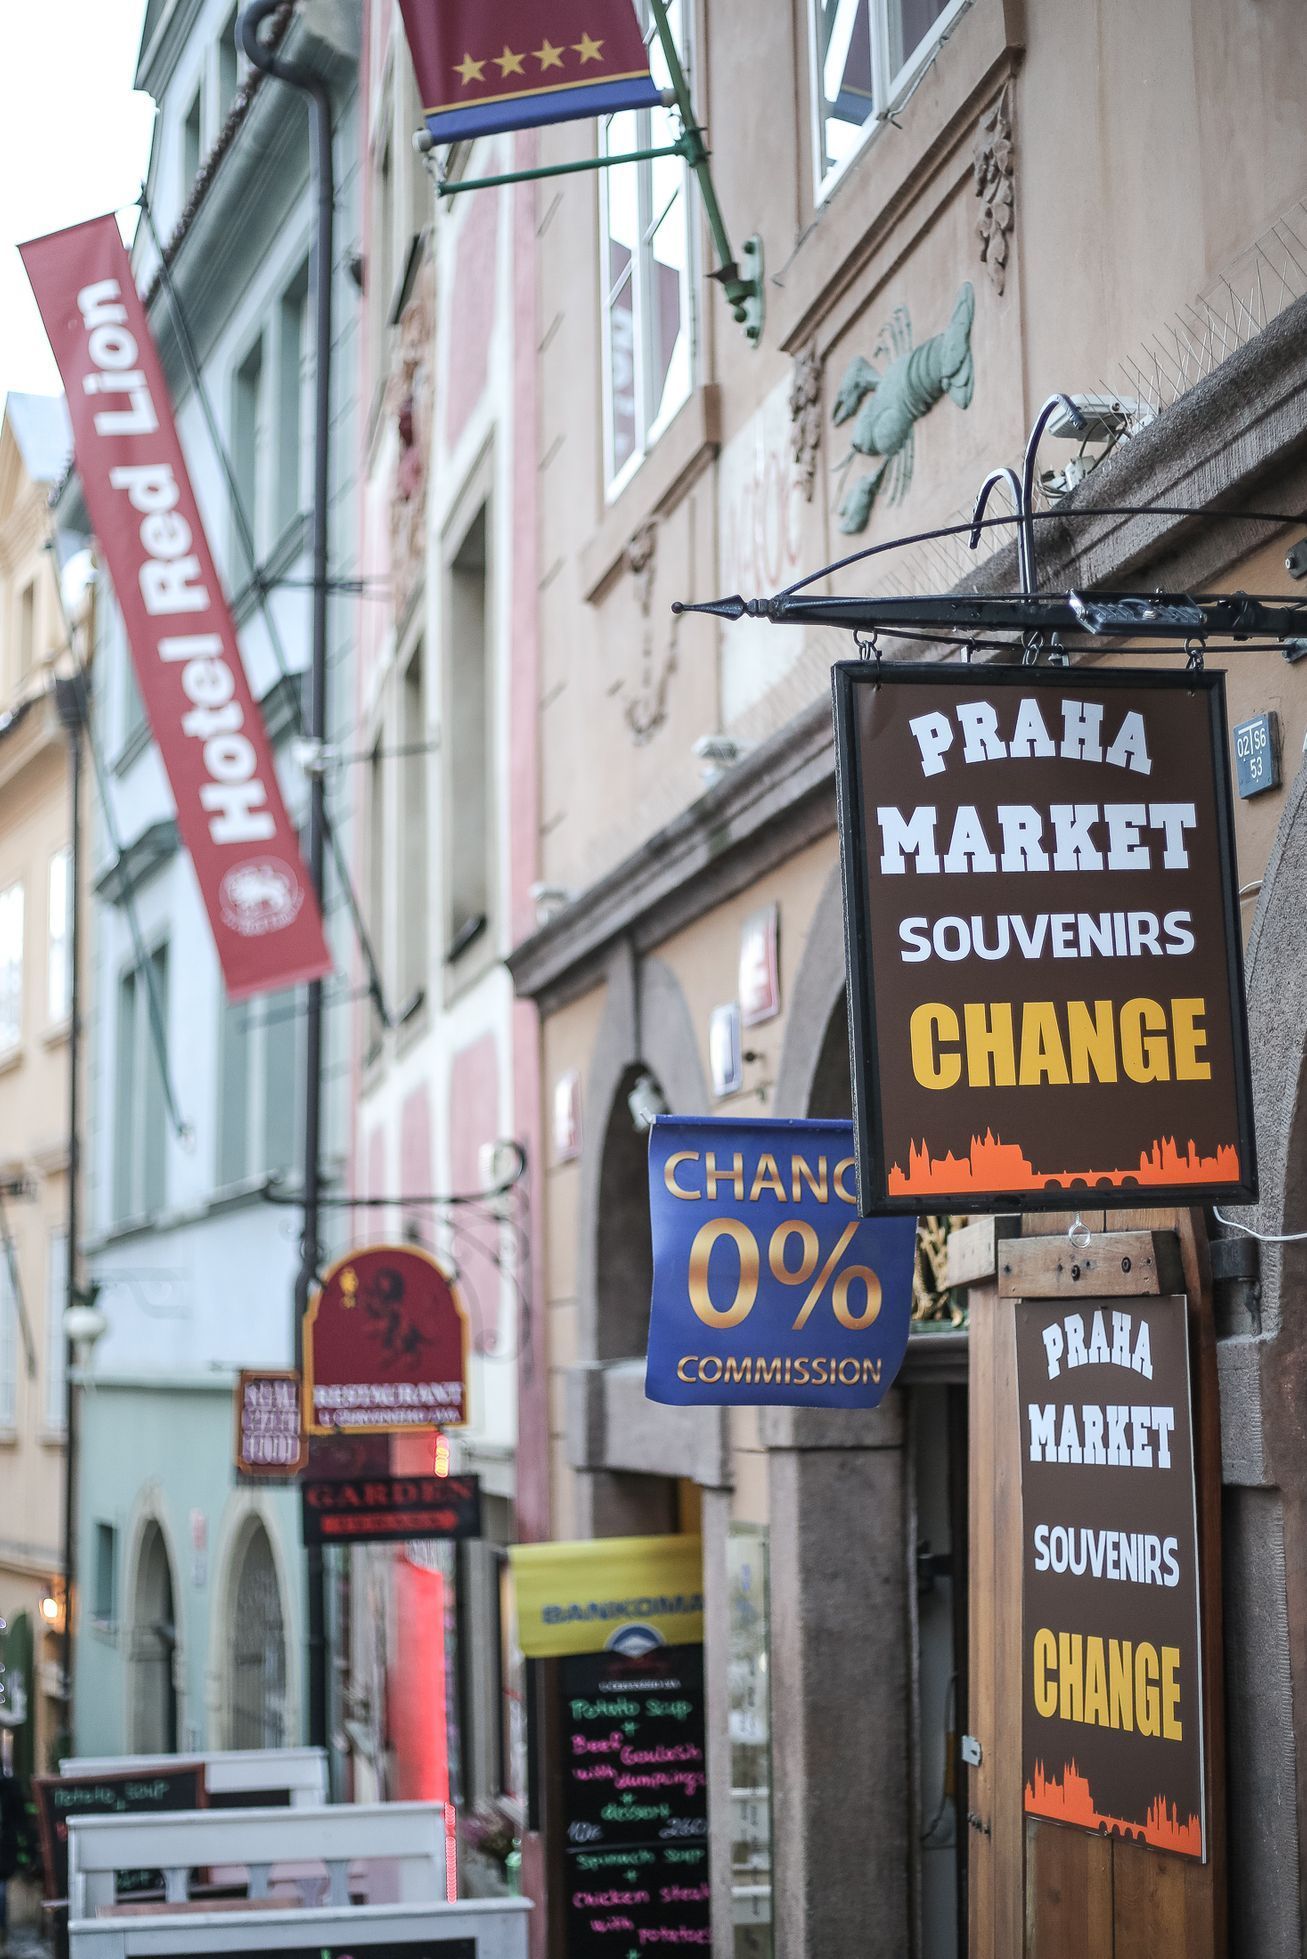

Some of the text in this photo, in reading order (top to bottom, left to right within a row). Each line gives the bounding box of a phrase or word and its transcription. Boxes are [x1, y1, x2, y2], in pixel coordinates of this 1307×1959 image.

[77, 278, 159, 436] Lion
[109, 463, 210, 616] Red
[157, 633, 277, 845] Hotel
[908, 698, 1152, 777] PRAHA
[1250, 757, 1263, 778] 53
[877, 803, 1197, 874] MARKET
[900, 911, 1195, 962] SOUVENIRS
[909, 998, 1212, 1090] CHANGE
[688, 1217, 883, 1331] 0%
[676, 1355, 883, 1385] COMMISSION
[1042, 1310, 1154, 1381] PRAHA
[1028, 1403, 1175, 1469] MARKET
[306, 1481, 473, 1508] GARDEN
[1033, 1524, 1180, 1587] SOUVENIRS
[543, 1594, 704, 1624] BANKOMA
[1033, 1627, 1183, 1741] CHANGE
